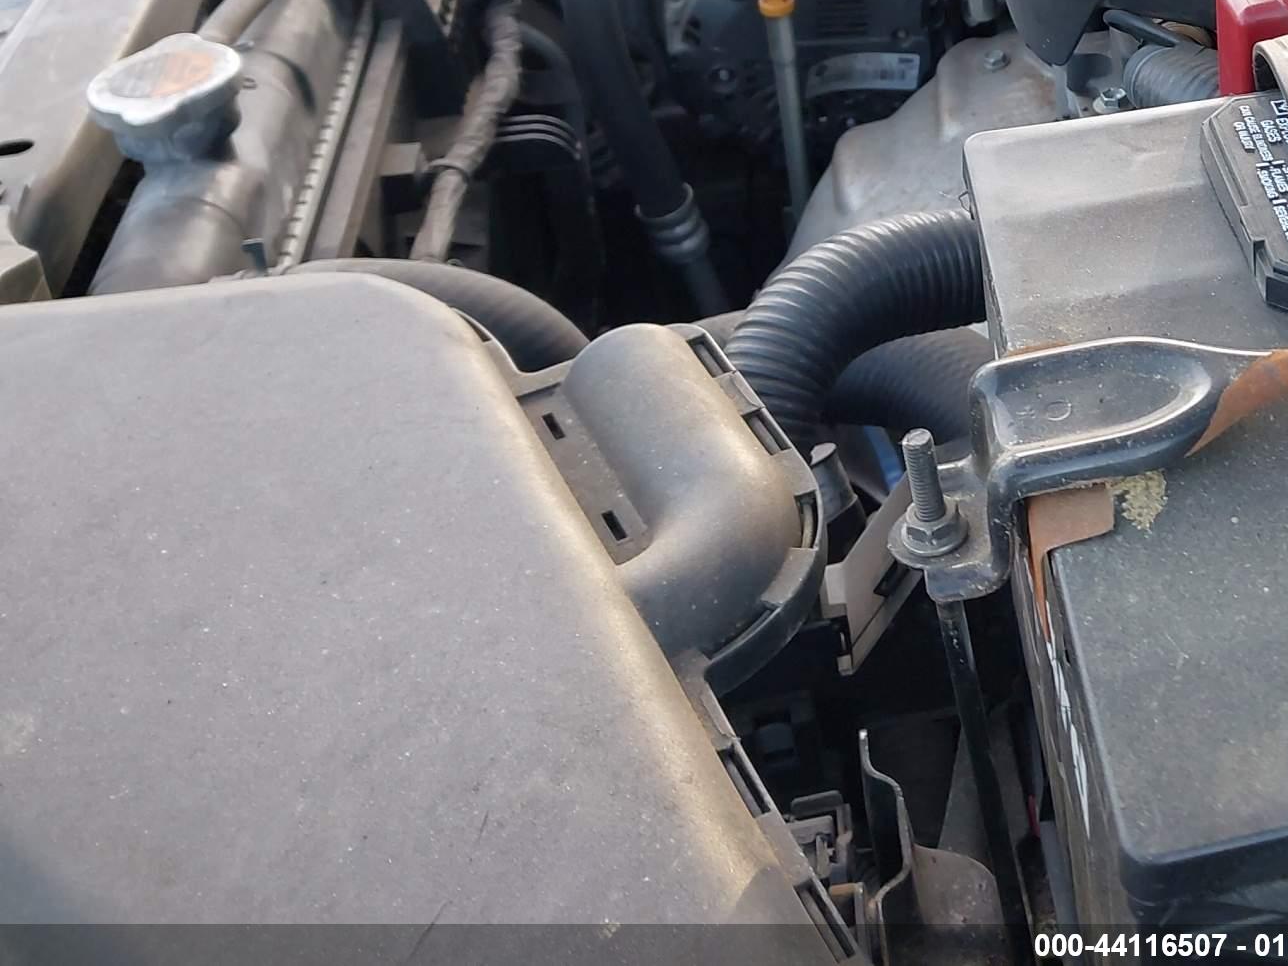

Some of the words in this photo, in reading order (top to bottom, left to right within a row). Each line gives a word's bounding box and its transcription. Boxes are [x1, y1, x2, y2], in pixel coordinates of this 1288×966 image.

[1239, 105, 1252, 117] CAN
[1233, 122, 1246, 131] OR
[1244, 117, 1260, 134] CAUSE
[1260, 120, 1282, 142] GASES
[1238, 131, 1255, 149] INJURY
[1252, 134, 1274, 161] BLINDNESS
[1257, 170, 1279, 198] SMOKING
